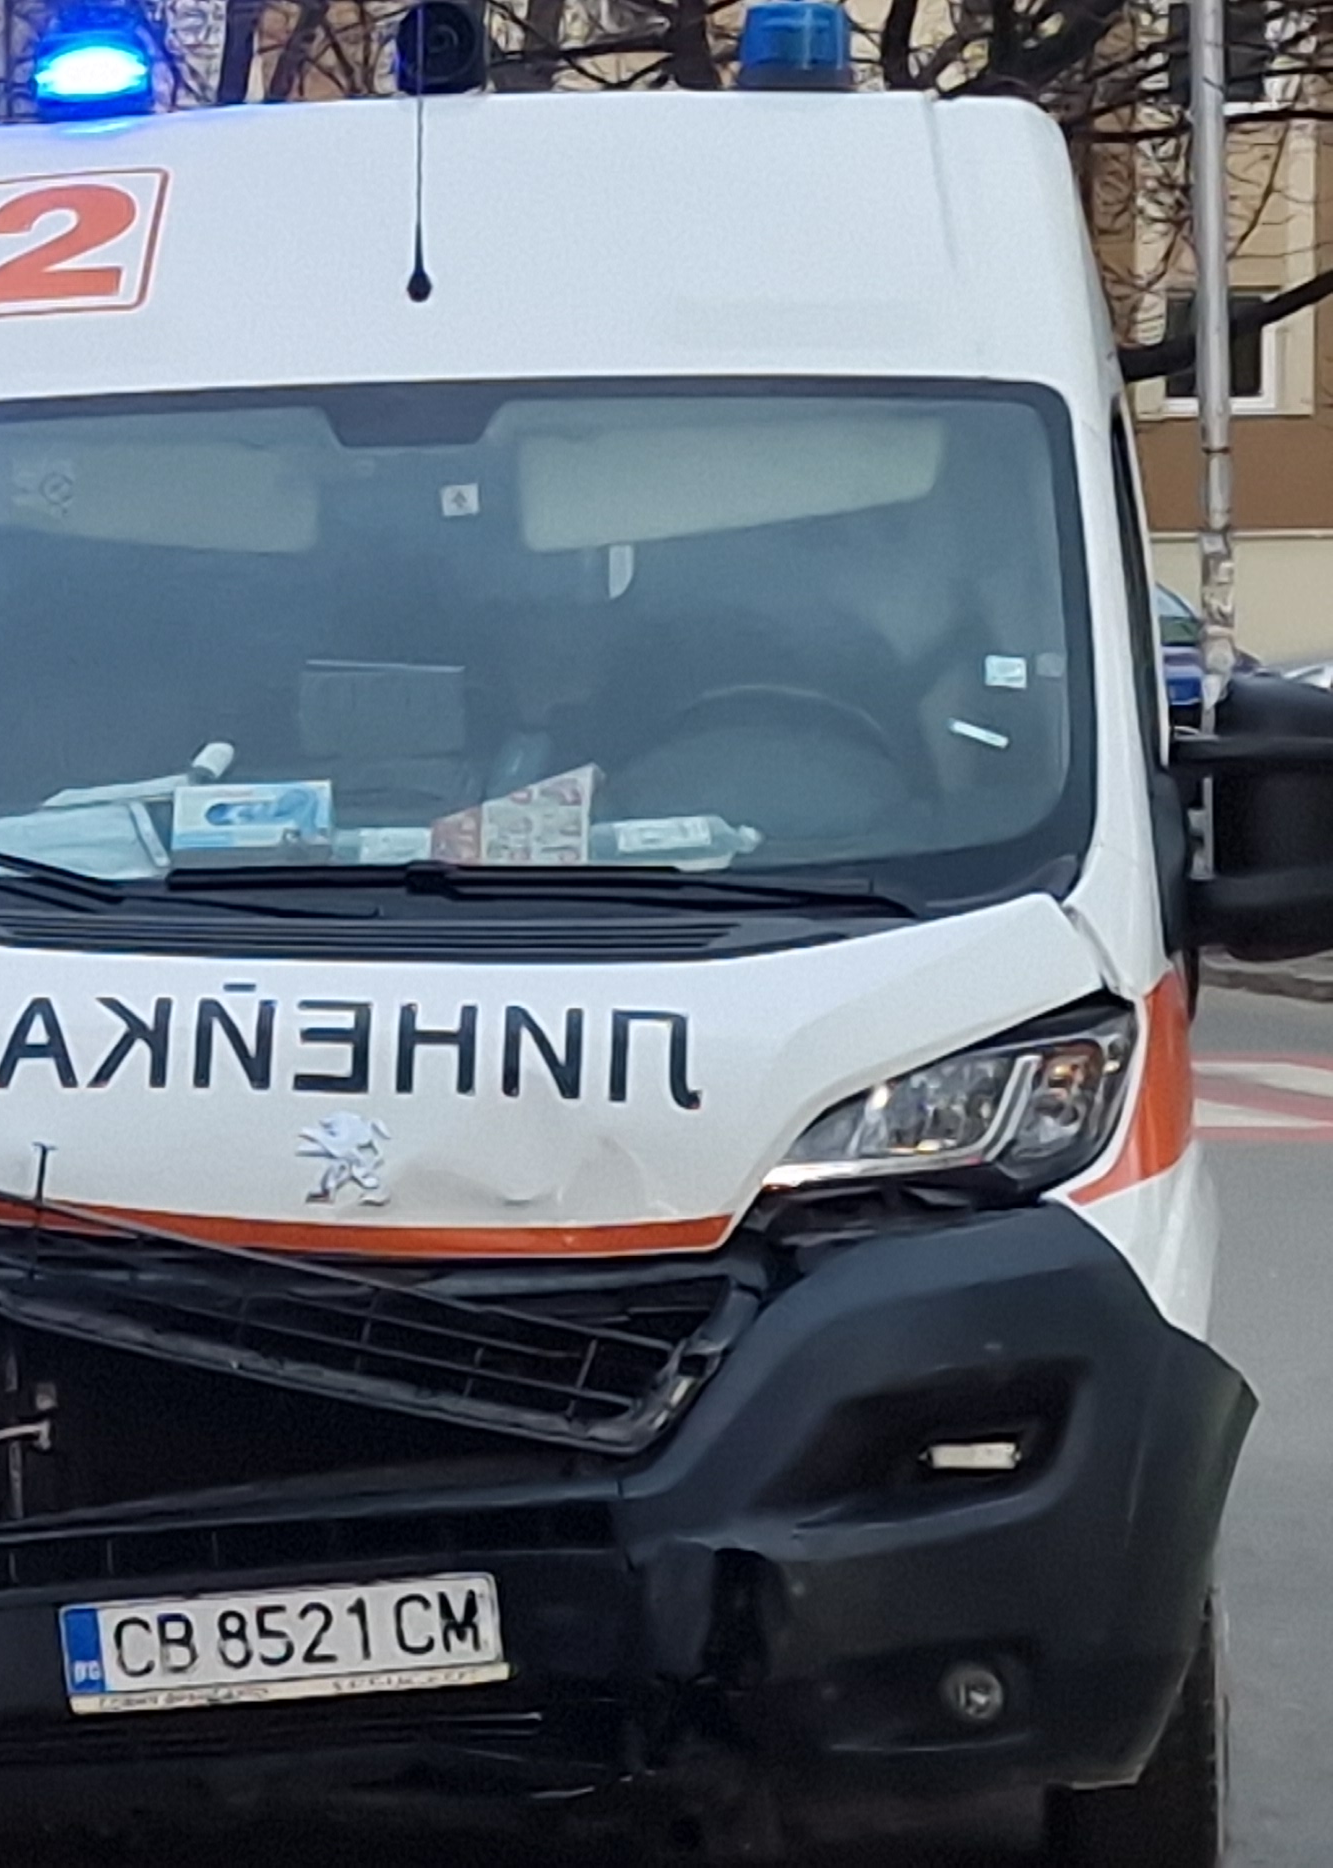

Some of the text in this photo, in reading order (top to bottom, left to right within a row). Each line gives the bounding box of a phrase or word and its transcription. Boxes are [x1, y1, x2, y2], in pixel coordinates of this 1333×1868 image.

[113, 1588, 482, 1677] CB 8521 CM
